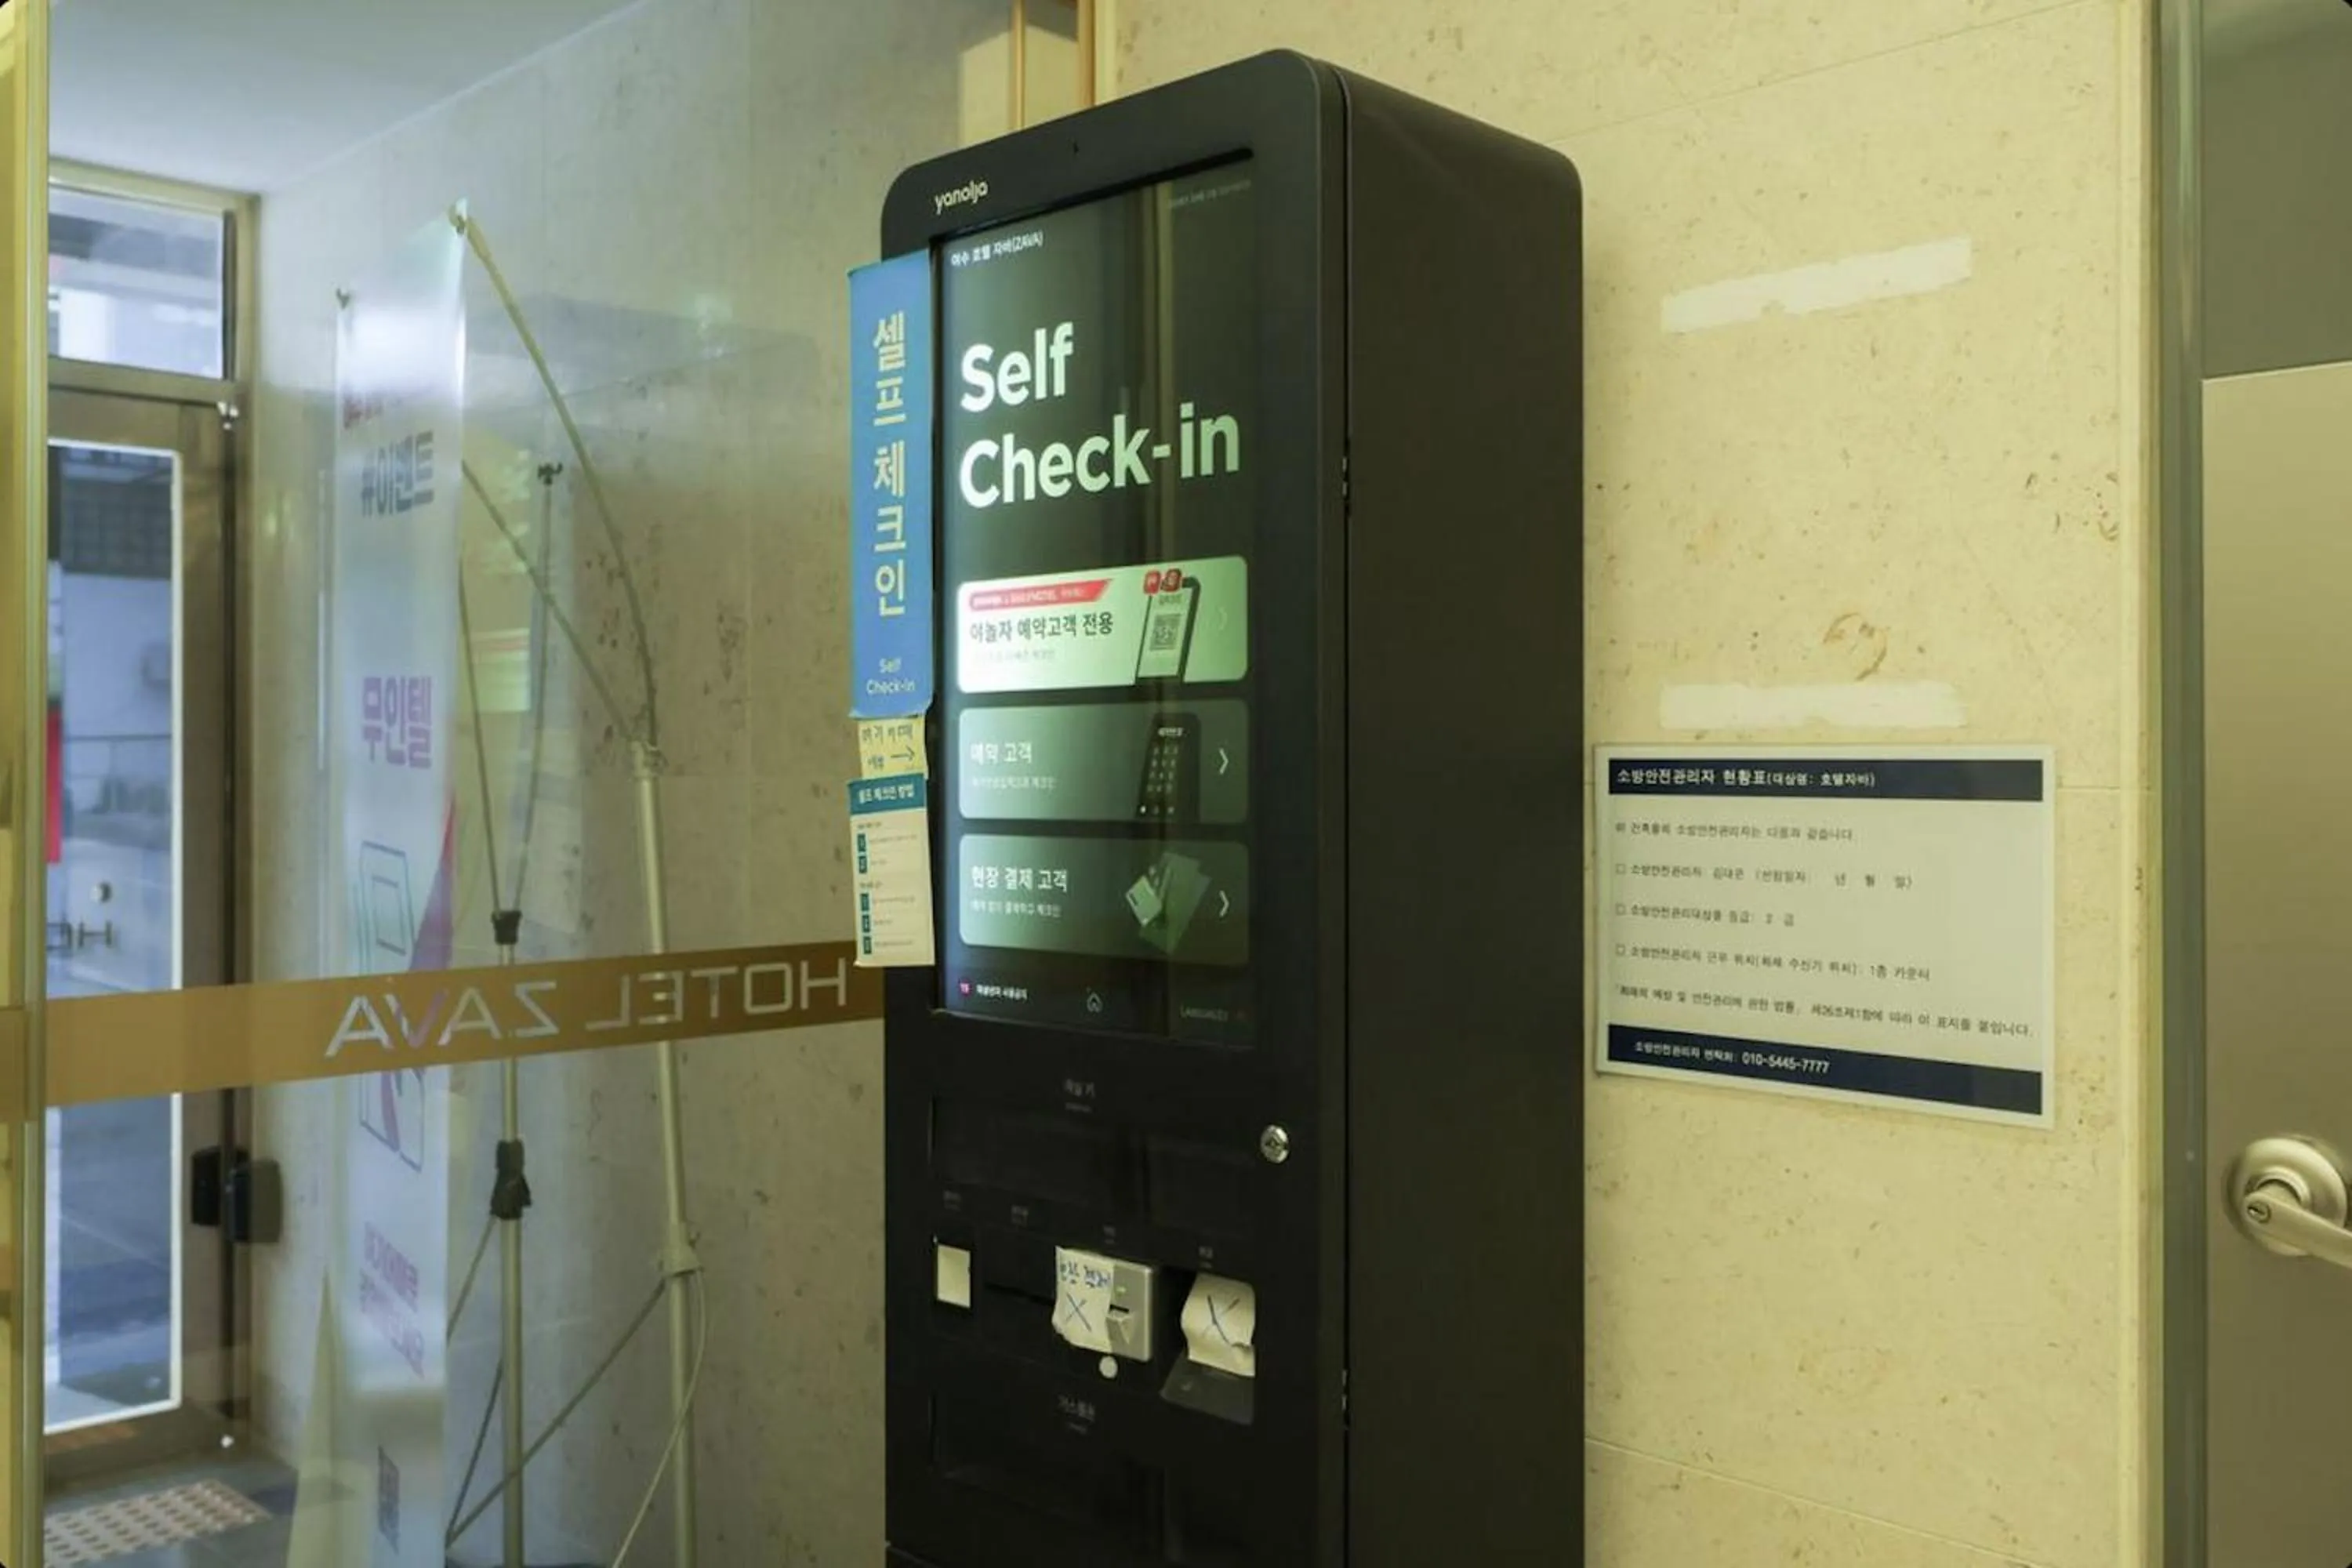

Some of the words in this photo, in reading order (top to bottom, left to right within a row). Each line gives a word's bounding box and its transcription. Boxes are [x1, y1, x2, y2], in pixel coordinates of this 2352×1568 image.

[935, 180, 989, 216] yanolja
[873, 310, 906, 426] 셀프
[960, 321, 1075, 412] Self
[959, 401, 1240, 509] Check-in
[873, 441, 907, 618] 체크인
[1082, 612, 1114, 637] 전용
[361, 675, 433, 770] 무인텔
[1617, 768, 1715, 785] 소방안전관리자
[1037, 869, 1068, 892] 고객
[1742, 1051, 1831, 1074] 010-5445-7777
